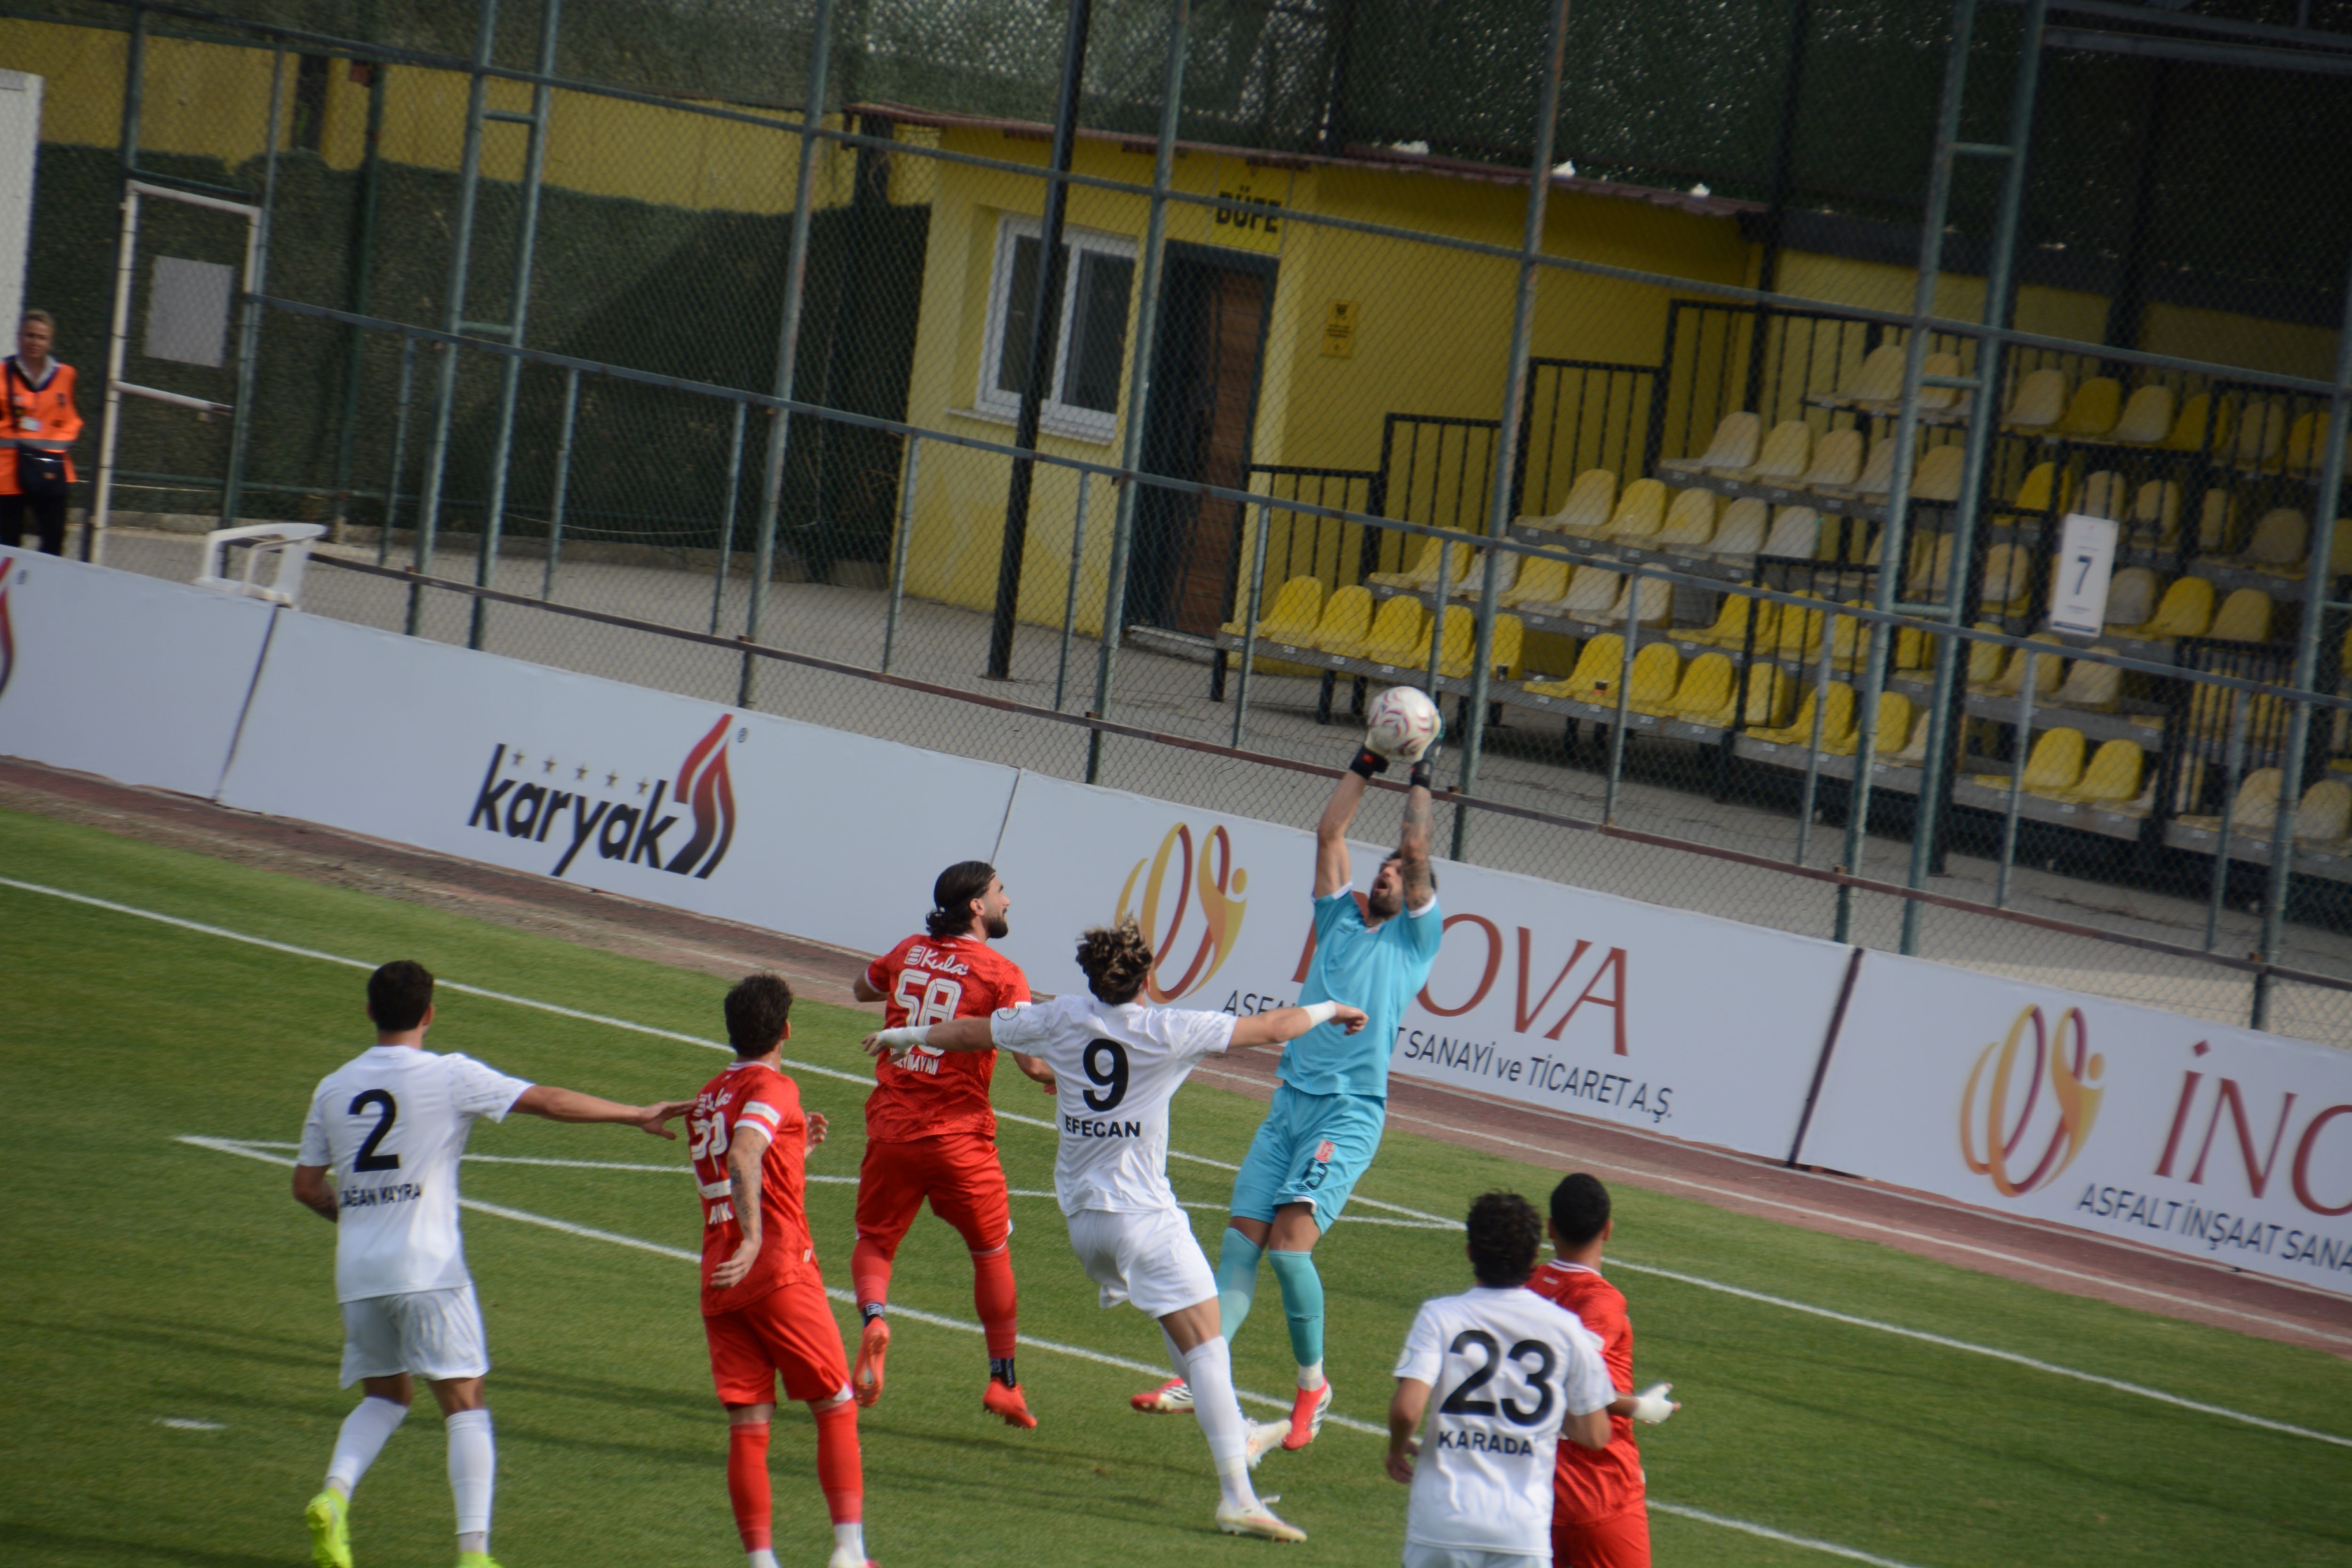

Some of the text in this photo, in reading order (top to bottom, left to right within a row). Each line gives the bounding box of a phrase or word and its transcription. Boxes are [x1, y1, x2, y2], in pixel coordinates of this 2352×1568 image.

[2074, 555, 2092, 596] 7
[467, 743, 679, 876] karyak
[895, 968, 962, 1057] 58
[1291, 890, 1629, 1057] OVA
[1083, 1038, 1129, 1112] 9
[1404, 1030, 1496, 1075] SANAYİ
[1498, 1057, 1522, 1082] ve
[1529, 1054, 1632, 1106] TİCARET
[1628, 1082, 1673, 1123] A.Ş.
[348, 1088, 400, 1172] 2
[1065, 1116, 1141, 1138] EFECAN
[2077, 1183, 2184, 1232] ASFALT
[2181, 1199, 2283, 1255] İNŞAAT
[1439, 1329, 1555, 1427] 23
